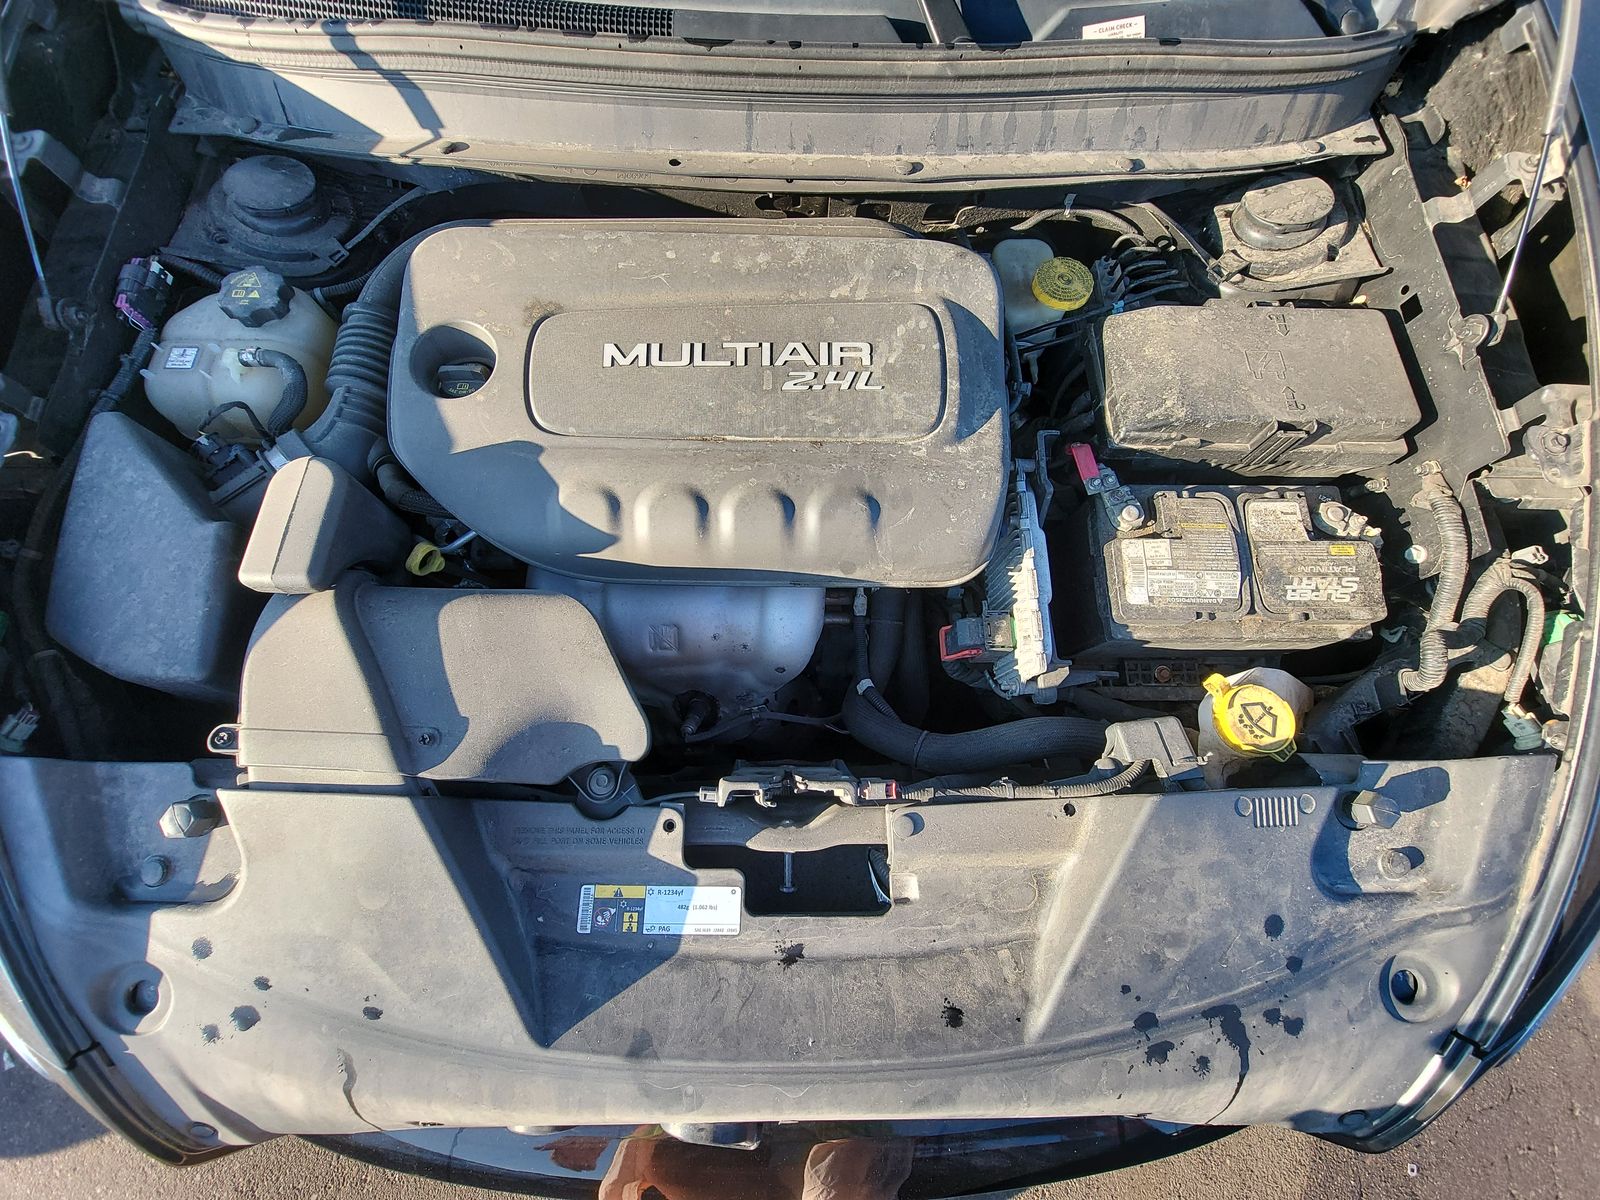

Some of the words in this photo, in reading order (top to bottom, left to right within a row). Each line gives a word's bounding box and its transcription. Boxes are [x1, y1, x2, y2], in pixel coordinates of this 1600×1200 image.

[1098, 26, 1115, 34] CLAIM
[1115, 22, 1133, 30] CHECK
[602, 342, 874, 368] MULTIAIR
[781, 371, 884, 391] 2.4L
[1298, 565, 1356, 573] PLATINUM
[1284, 577, 1361, 592] START
[1286, 589, 1351, 603] SUPER
[566, 826, 589, 834] PANEL
[590, 826, 605, 834] FOR
[607, 826, 635, 834] ACCESS
[585, 837, 606, 845] SOME
[608, 837, 644, 845] VEHICLES
[657, 889, 684, 897] R-1234yf
